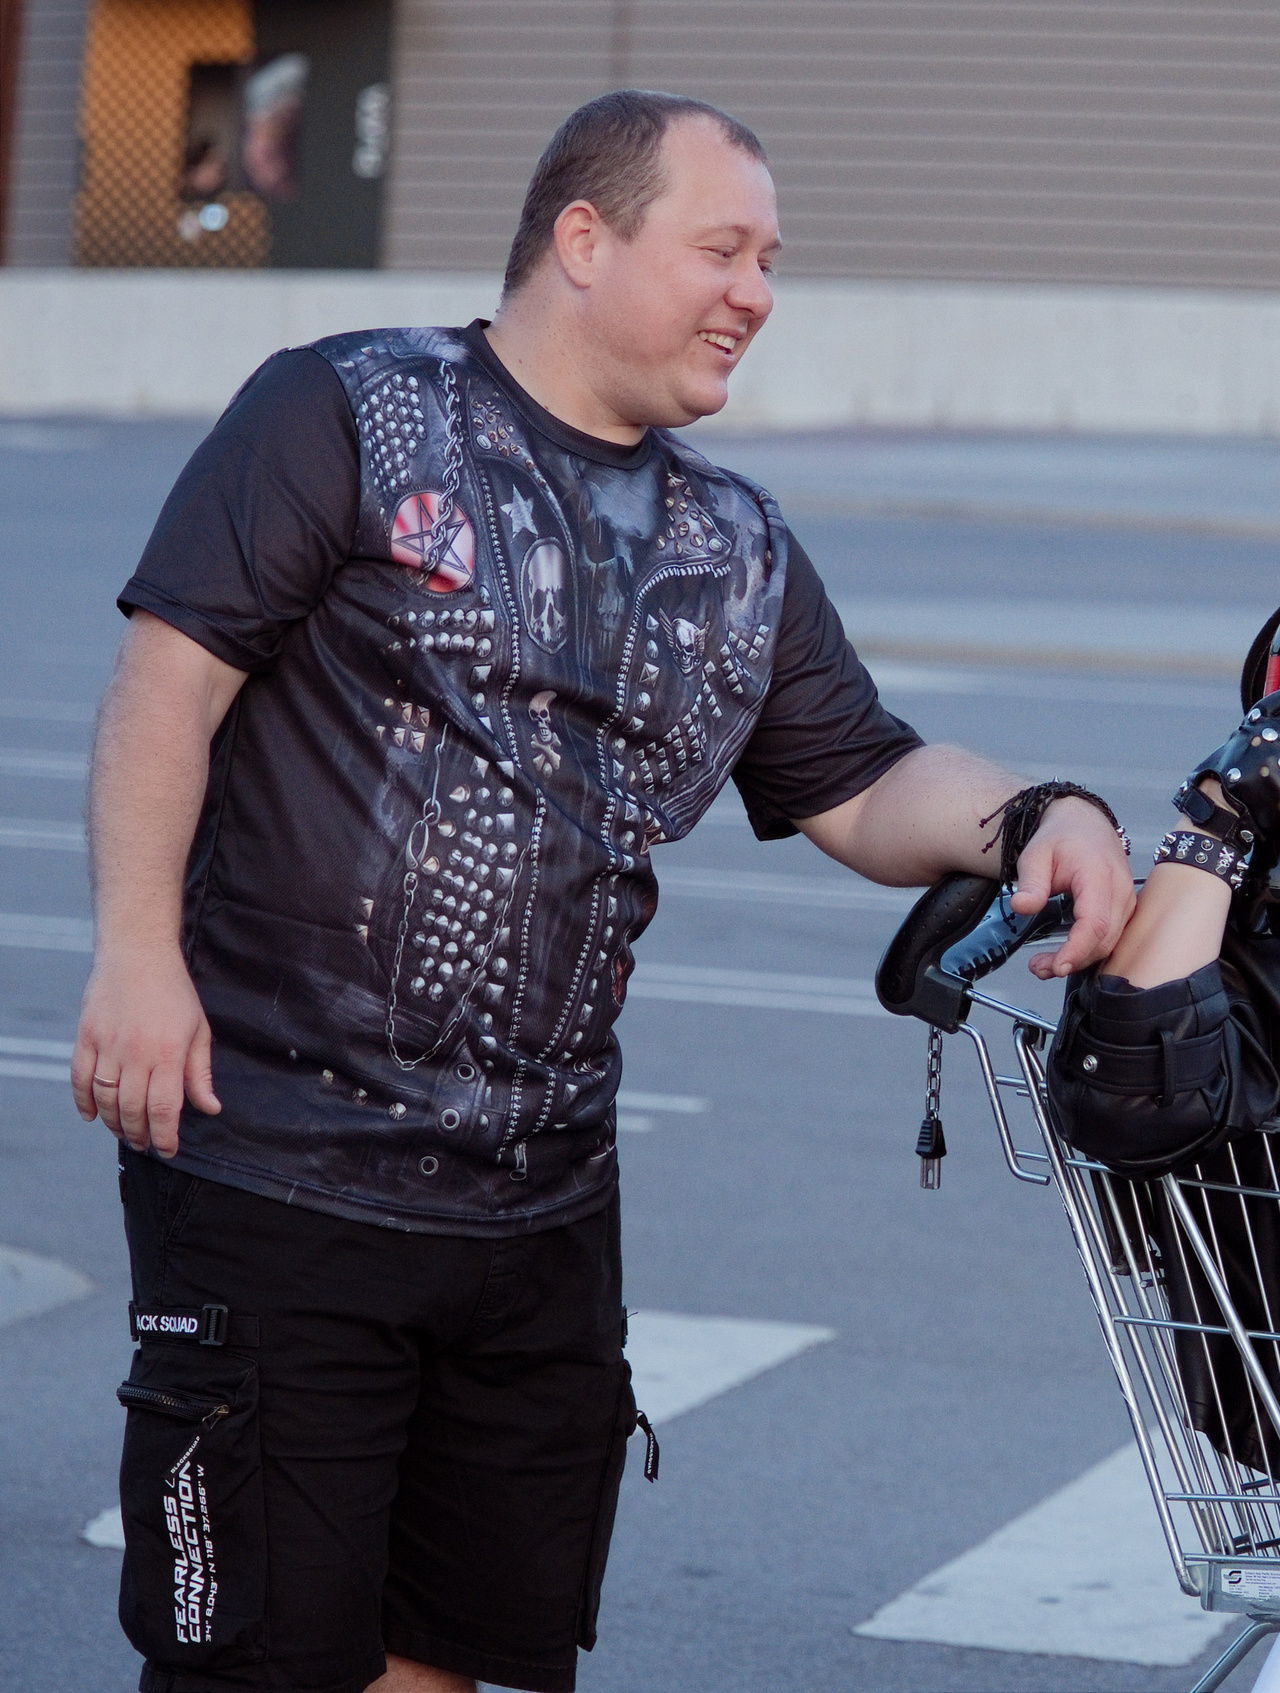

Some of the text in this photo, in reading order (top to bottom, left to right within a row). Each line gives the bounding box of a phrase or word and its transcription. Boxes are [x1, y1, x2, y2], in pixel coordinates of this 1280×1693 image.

[160, 1316, 198, 1333] SQUAD
[196, 1464, 205, 1477] W
[163, 1495, 189, 1643] FEARLESS
[208, 1562, 217, 1574] N
